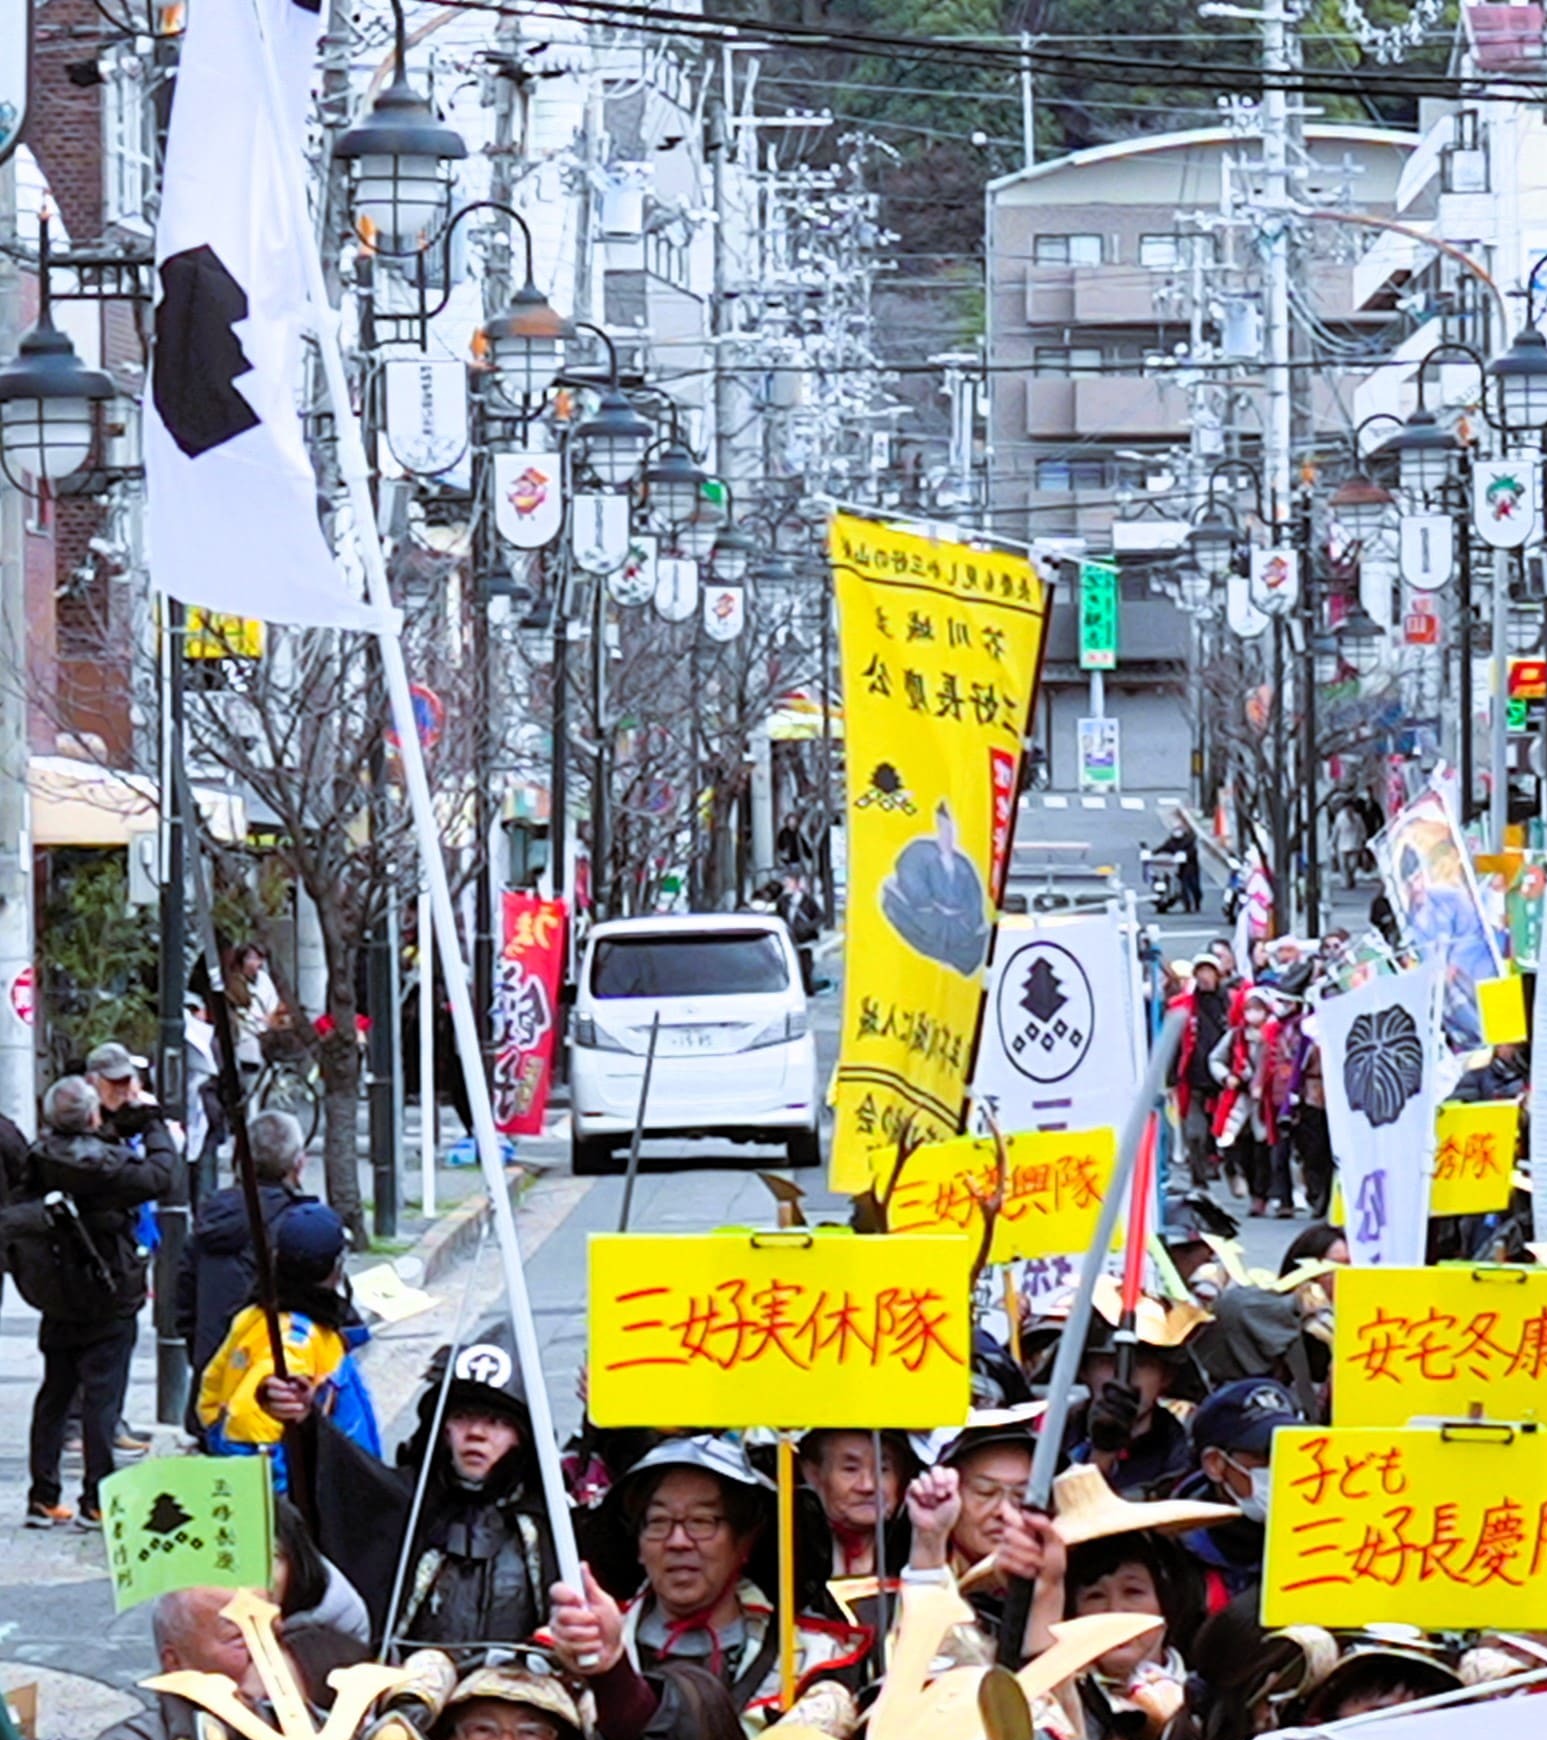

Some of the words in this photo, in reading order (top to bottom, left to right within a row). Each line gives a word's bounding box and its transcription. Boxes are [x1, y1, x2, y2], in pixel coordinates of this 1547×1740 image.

[604, 1276, 967, 1374] 三好実休隊
[1289, 1438, 1410, 1503] 子ども
